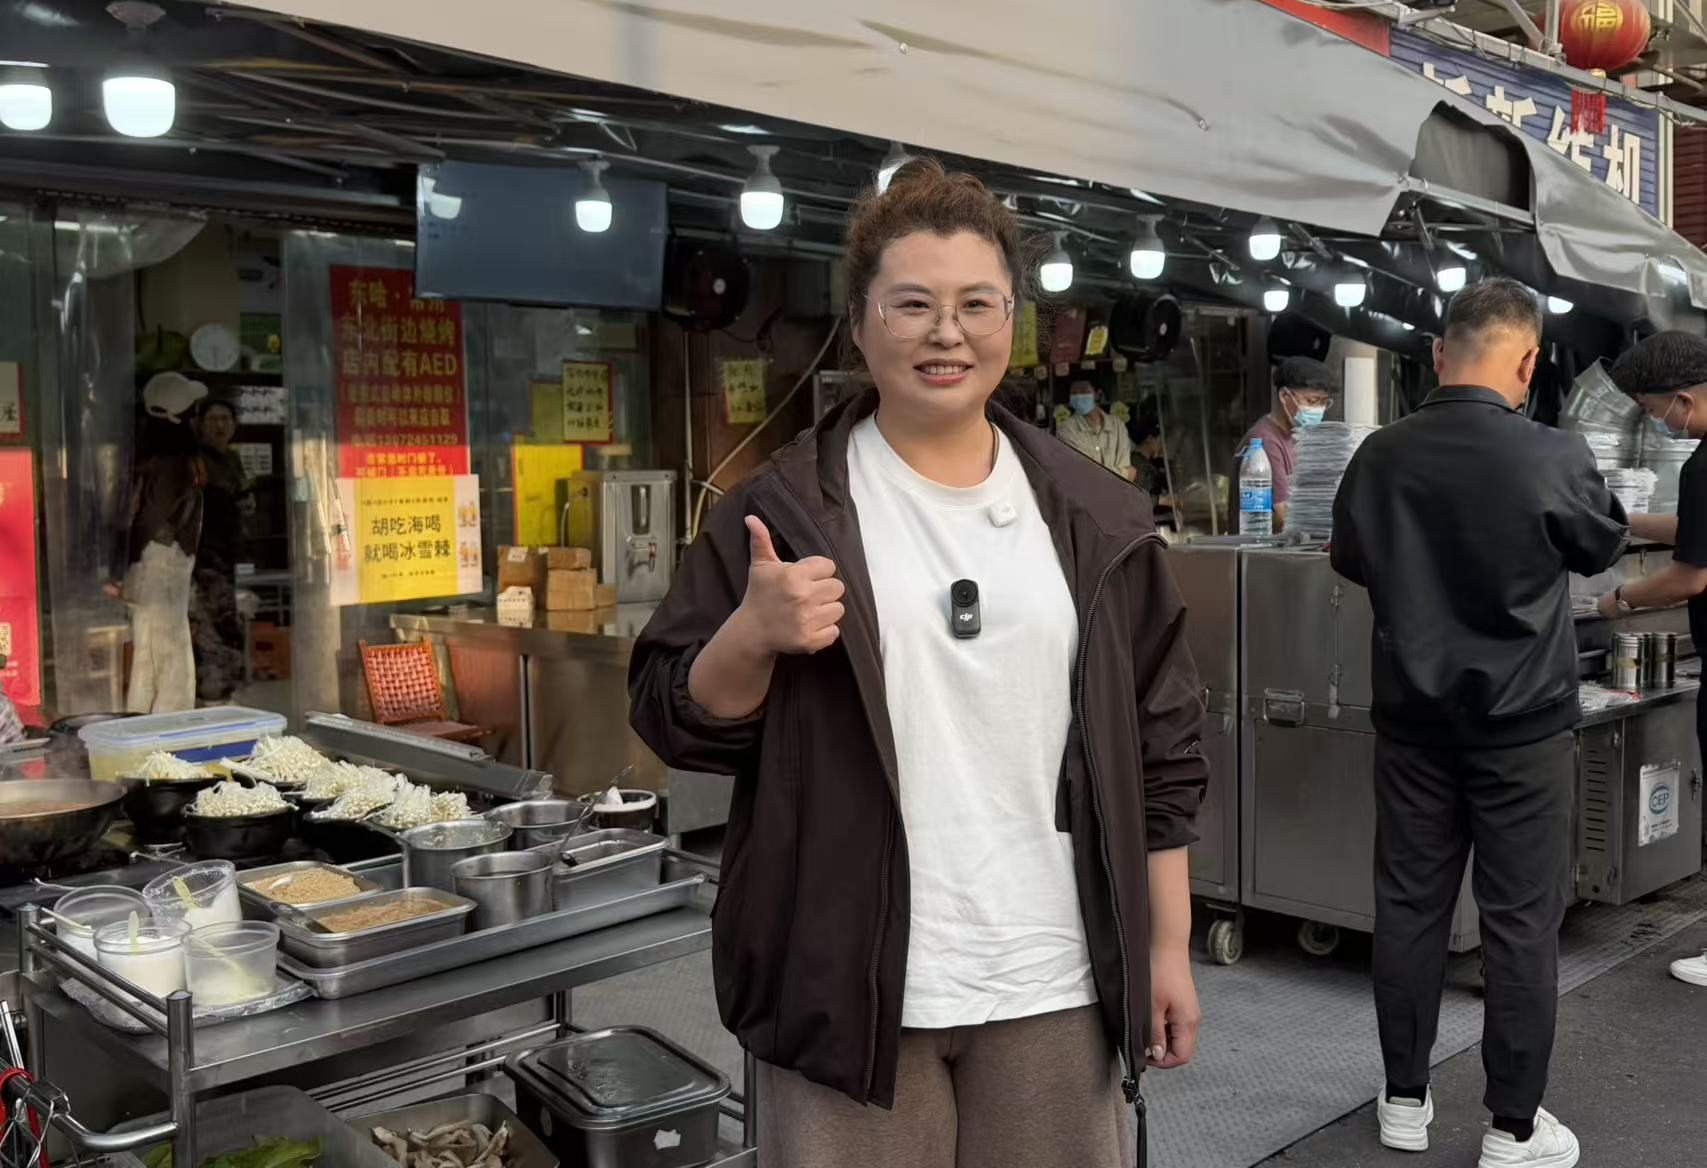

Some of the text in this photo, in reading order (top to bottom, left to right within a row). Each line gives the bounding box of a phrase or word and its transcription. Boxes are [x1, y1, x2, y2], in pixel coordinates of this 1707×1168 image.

[371, 513, 441, 536] 胡吃海喝
[364, 539, 451, 563] 就喝冰雪棘
